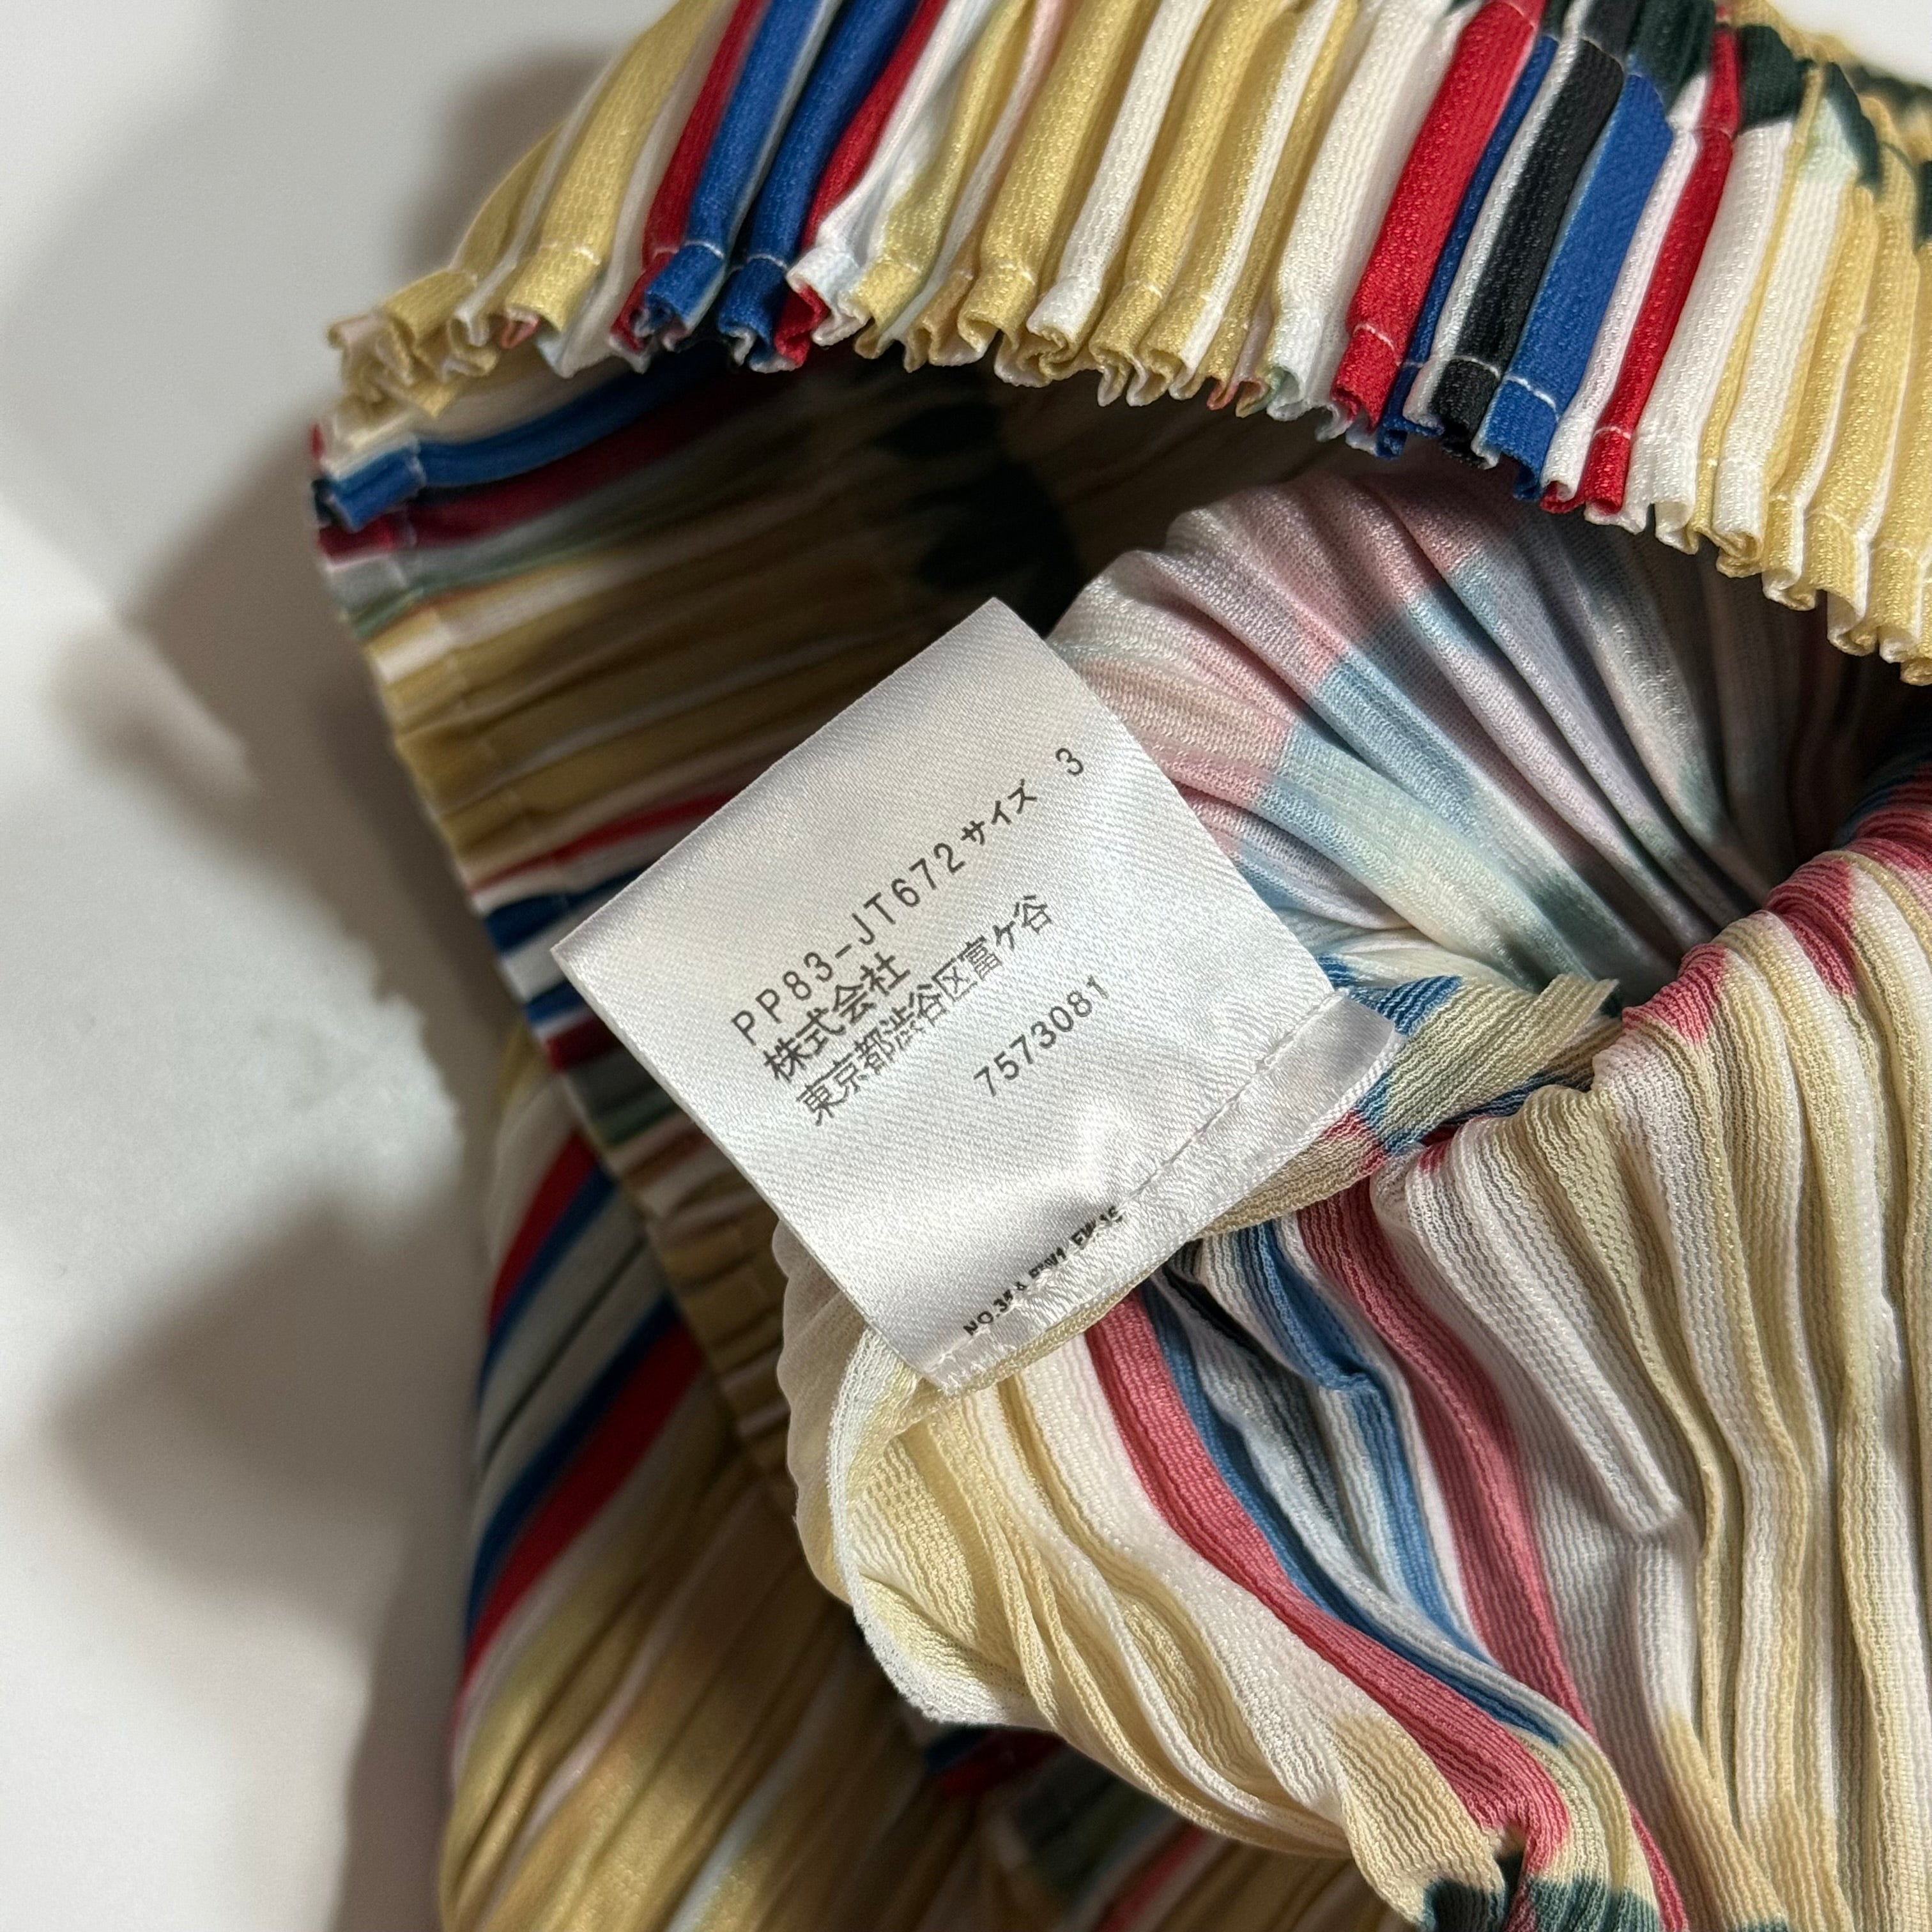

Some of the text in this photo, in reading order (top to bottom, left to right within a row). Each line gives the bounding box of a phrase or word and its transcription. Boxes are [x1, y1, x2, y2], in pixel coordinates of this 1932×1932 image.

[1055, 747, 1084, 777] 3
[762, 951, 911, 1085] 株式会社
[973, 974, 1109, 1098] 7573081
